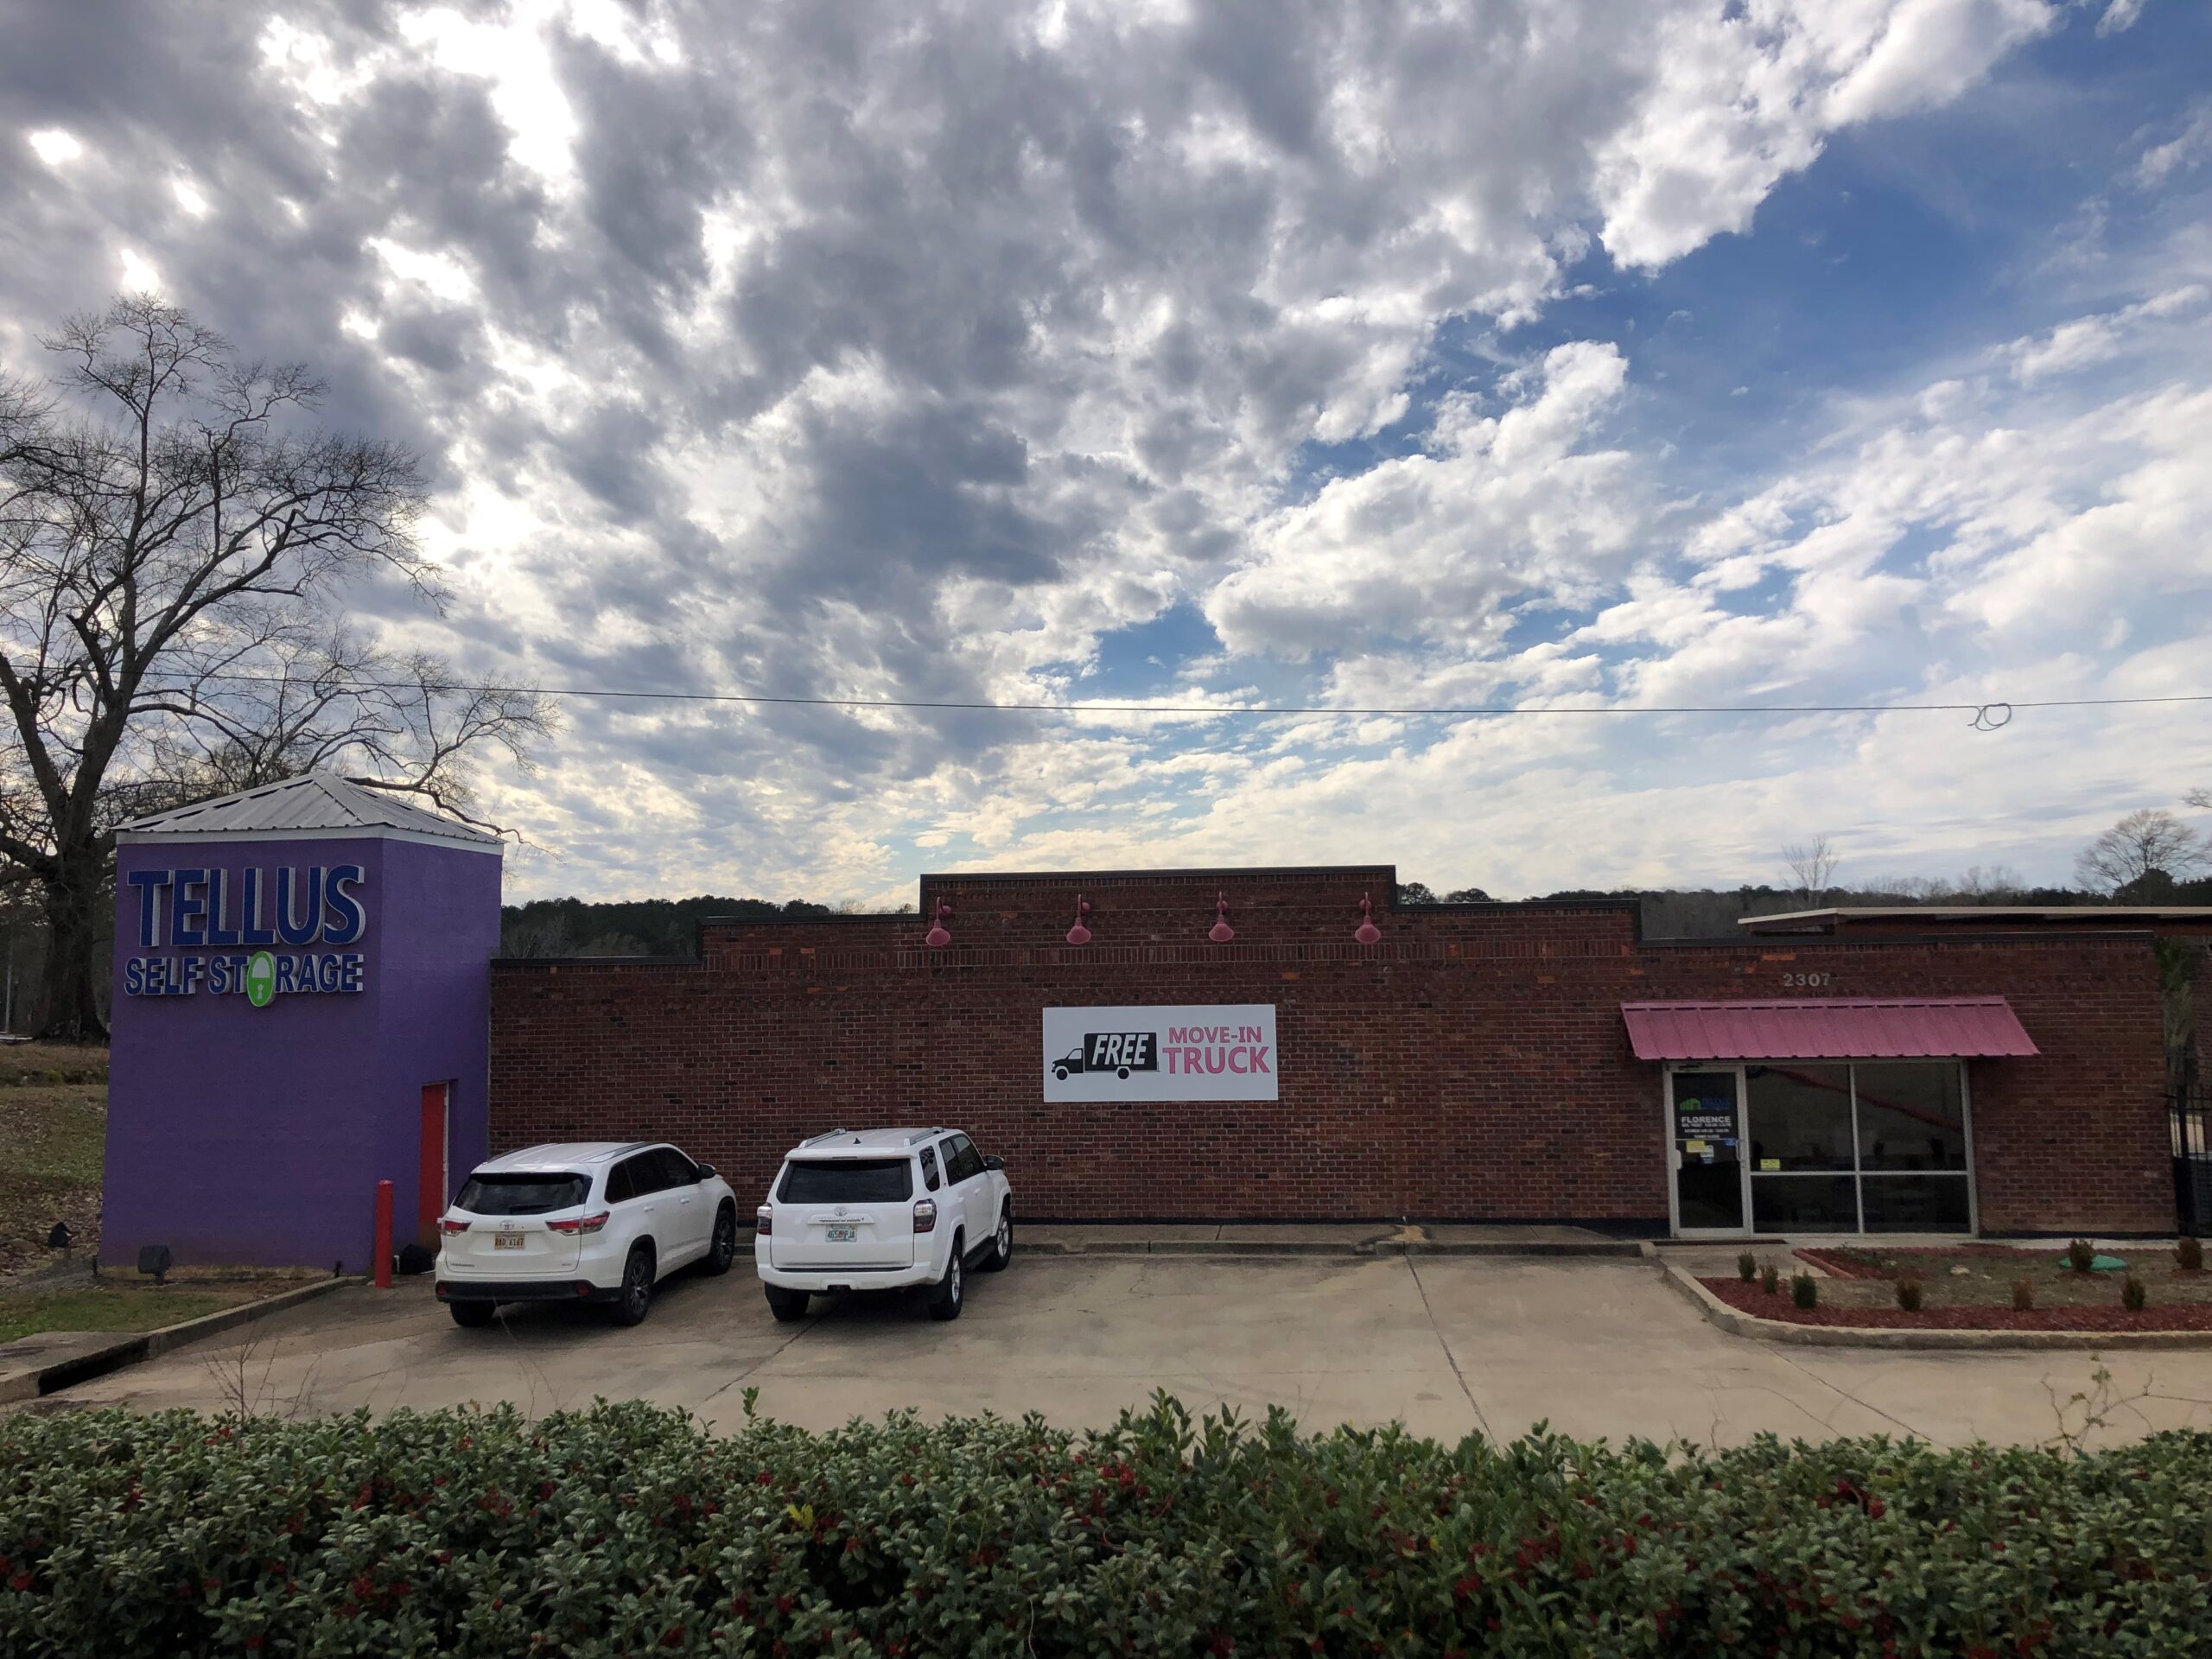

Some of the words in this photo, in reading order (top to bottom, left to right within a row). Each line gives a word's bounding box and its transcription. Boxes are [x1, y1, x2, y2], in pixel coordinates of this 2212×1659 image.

[127, 865, 365, 947] TELLUS
[124, 957, 205, 995] SELF
[208, 950, 363, 1007] STORAGE
[1783, 973, 1830, 986] 2307
[1092, 1034, 1149, 1065] FREE
[1168, 1027, 1262, 1044] MOVE-IN
[1162, 1046, 1270, 1074] TRUCK
